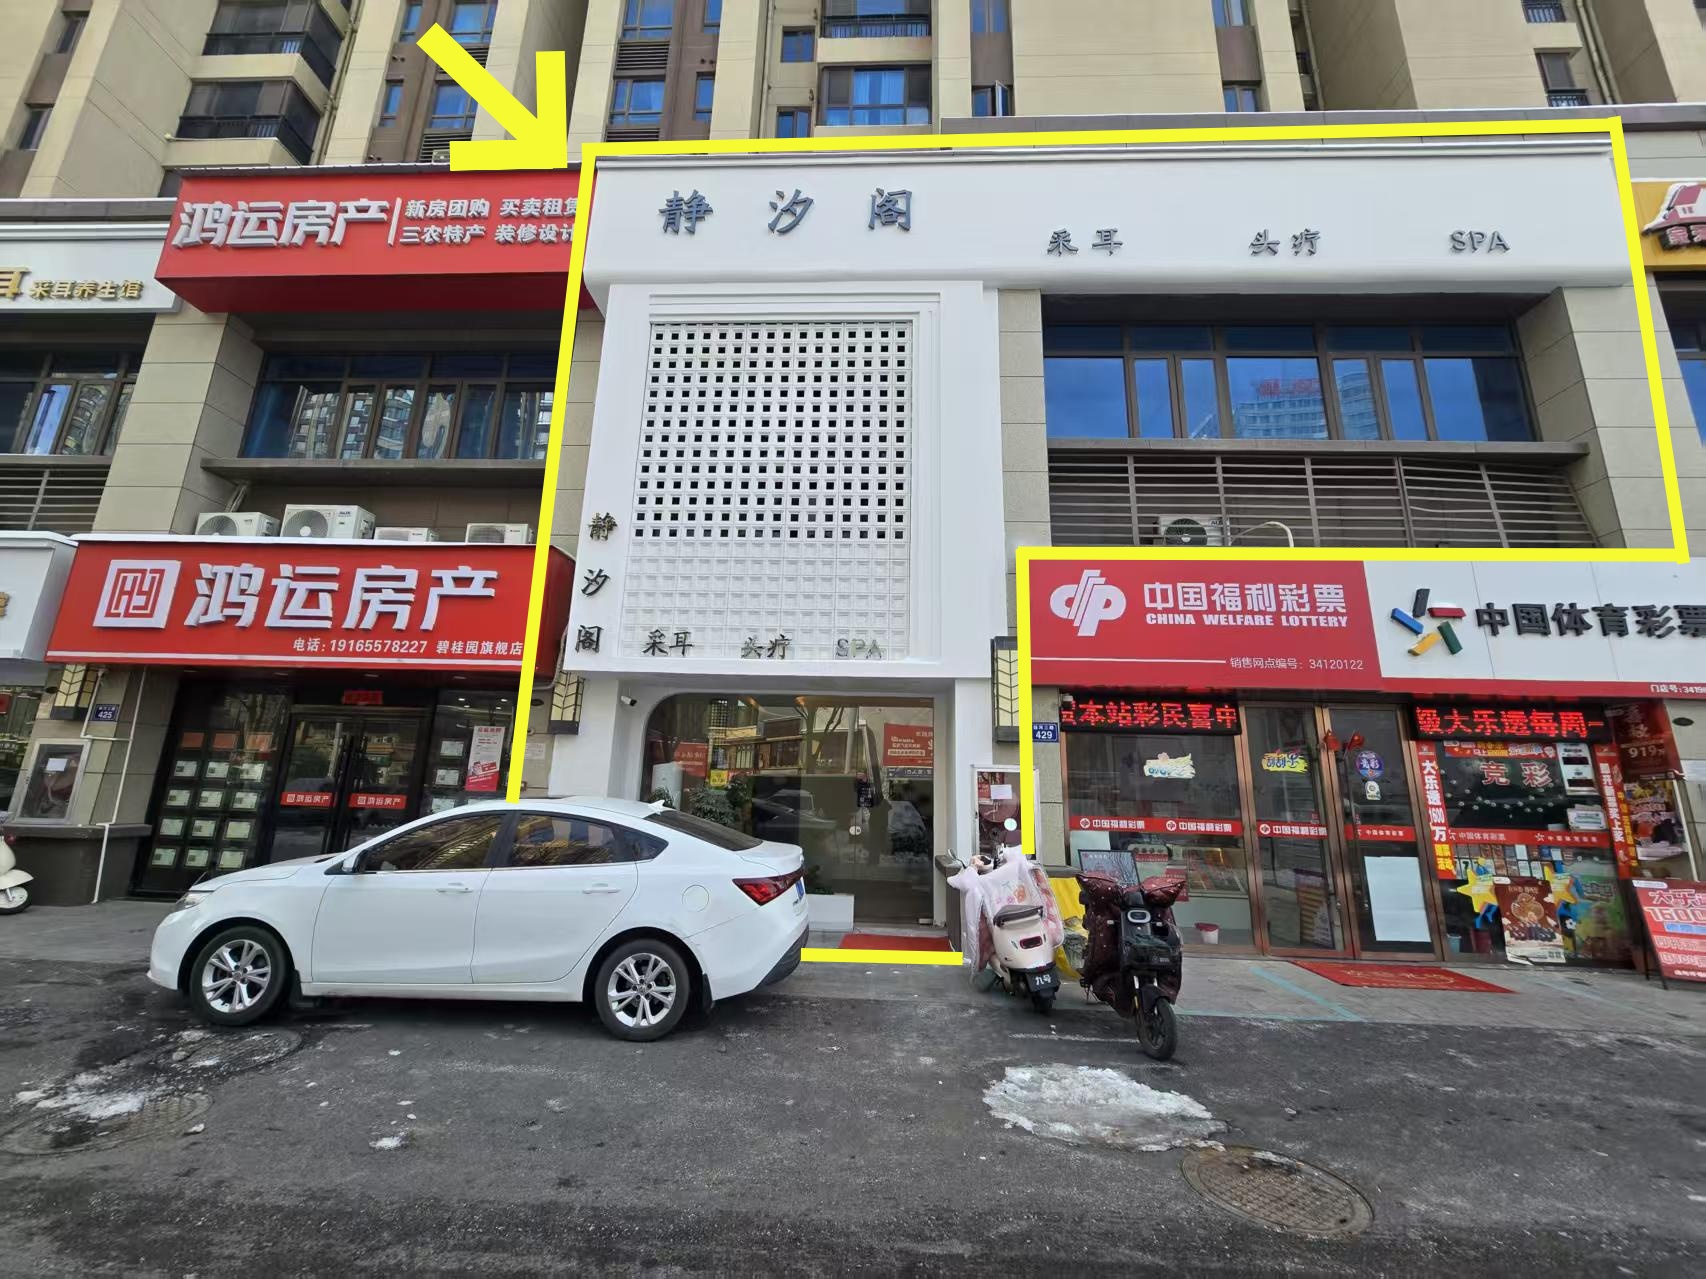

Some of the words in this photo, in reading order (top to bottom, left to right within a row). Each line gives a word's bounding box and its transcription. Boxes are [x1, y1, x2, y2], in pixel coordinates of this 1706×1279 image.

[405, 199, 490, 219] 新房团购
[500, 198, 579, 219] 买卖租赁
[659, 189, 913, 235] 静汐阁
[172, 199, 390, 248] 鸿运房产
[400, 225, 486, 244] 三农特产
[1047, 229, 1124, 256] 采耳
[1249, 228, 1321, 256] 头疗
[1450, 230, 1511, 253] SPA
[184, 563, 499, 632] 鸿运房产
[1143, 582, 1347, 613] 中国福利彩票
[1146, 613, 1196, 625] CHINA
[1203, 614, 1274, 626] WELFARE
[1281, 615, 1348, 627] LOTTERY
[1475, 602, 1706, 639] 中国体育彩票
[436, 640, 524, 656] 碧桂园旗舰店
[643, 628, 694, 657] 采耳
[836, 638, 883, 660] SPA
[1309, 659, 1364, 670] 34120122
[1035, 730, 1053, 739] 429
[1480, 761, 1551, 787] 竞彩
[1035, 974, 1052, 986] 九号
